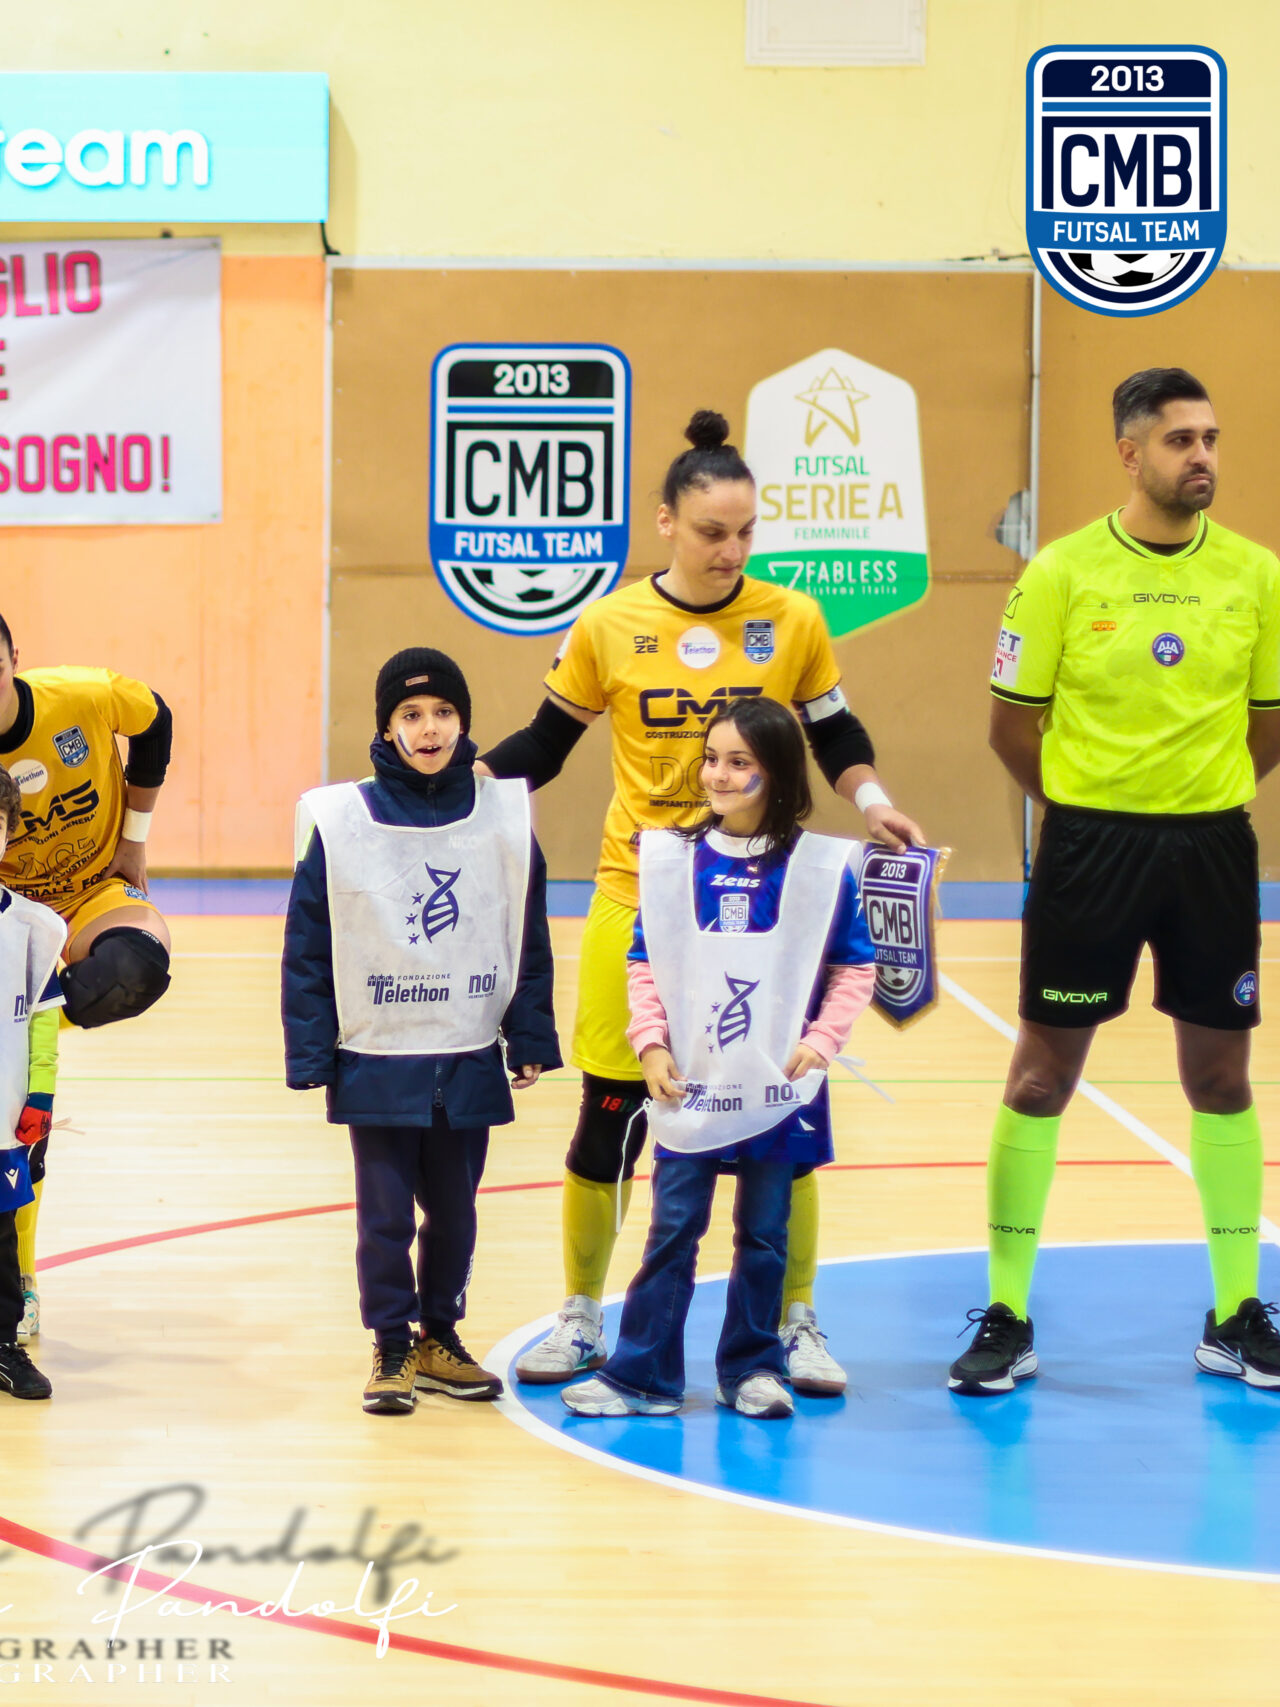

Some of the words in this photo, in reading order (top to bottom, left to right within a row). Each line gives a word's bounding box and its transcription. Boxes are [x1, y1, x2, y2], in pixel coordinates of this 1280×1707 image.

[493, 363, 571, 396] 2013
[794, 455, 870, 477] FUTSAL
[463, 439, 595, 519] CMB
[760, 483, 870, 521] SERIE
[877, 482, 904, 520] A
[794, 526, 871, 541] FEMMINILE
[454, 531, 540, 558] FUTSAL
[544, 531, 604, 558] TEAM
[805, 560, 898, 584] FABLESS
[1133, 593, 1201, 606] GIVOVA
[60, 738, 83, 756] CMB
[880, 862, 907, 879] 2013
[710, 873, 761, 888] Zeus
[724, 907, 744, 920] CMB
[869, 899, 913, 945] CMB
[875, 948, 898, 963] UTSAL
[898, 951, 918, 964] TEAM
[397, 972, 452, 982] FONDAZIONE
[468, 964, 498, 994] noi
[367, 973, 450, 1005] Telethon
[1043, 988, 1108, 1004] GIVOVA
[988, 1222, 1036, 1235] IVOVA
[1211, 1225, 1260, 1235] GIVOV
